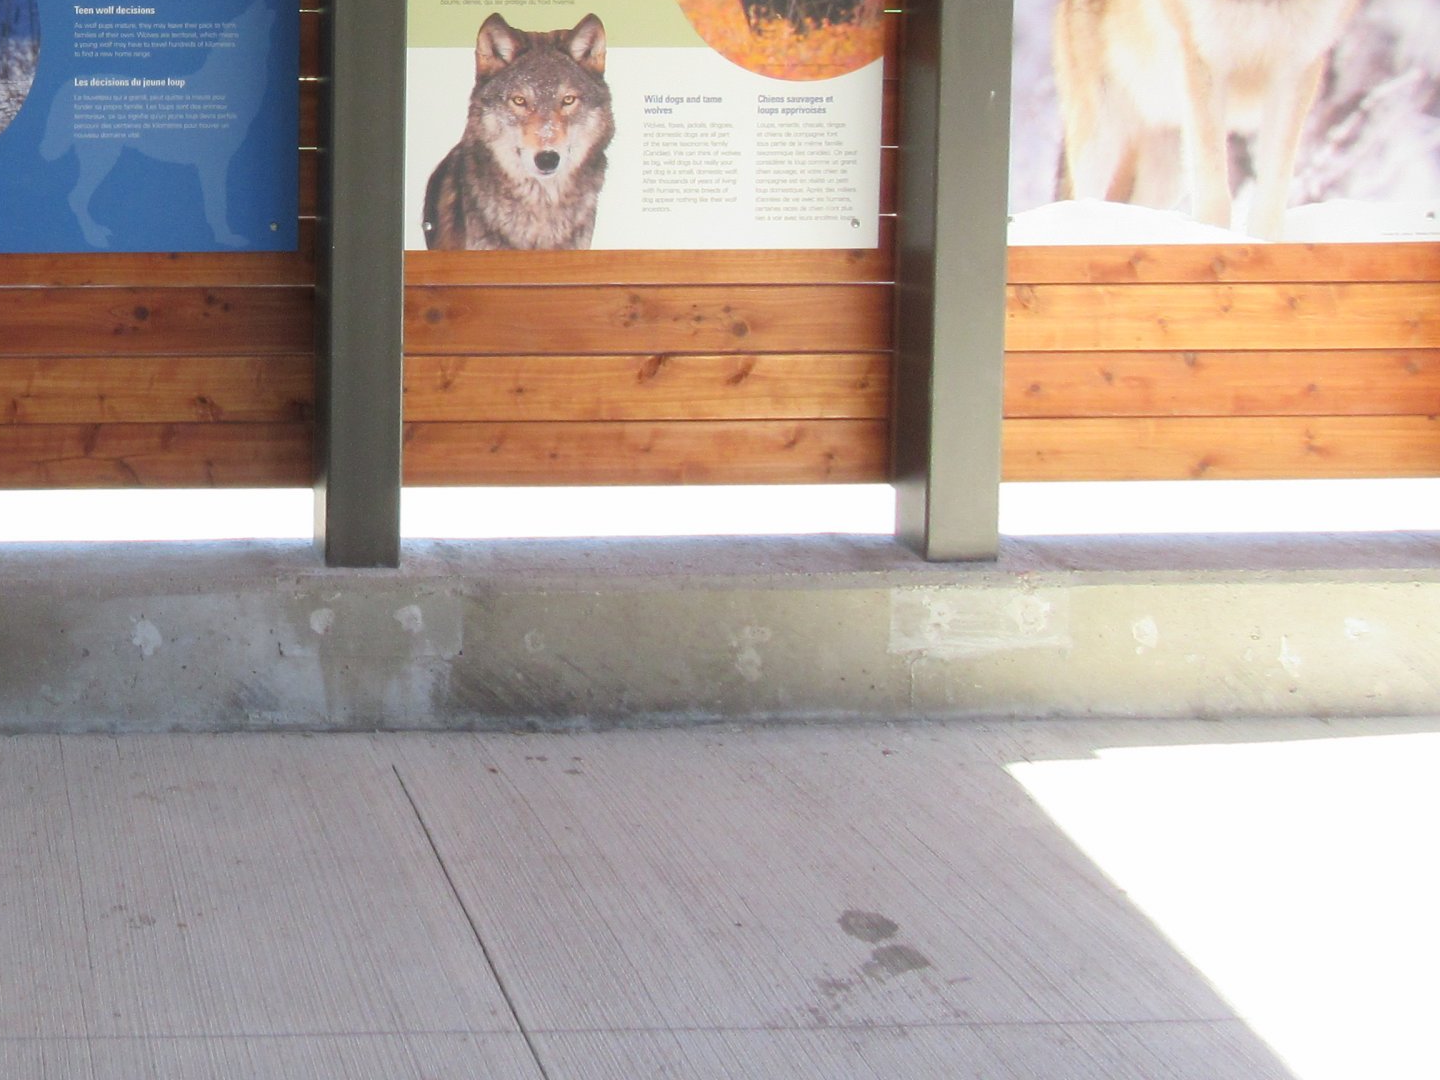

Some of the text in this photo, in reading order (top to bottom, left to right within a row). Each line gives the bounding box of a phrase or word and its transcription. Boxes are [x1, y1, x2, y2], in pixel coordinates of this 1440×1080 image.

[74, 5, 155, 15] Teen wolf decisions
[74, 77, 185, 89] Les décisions du jeune loup
